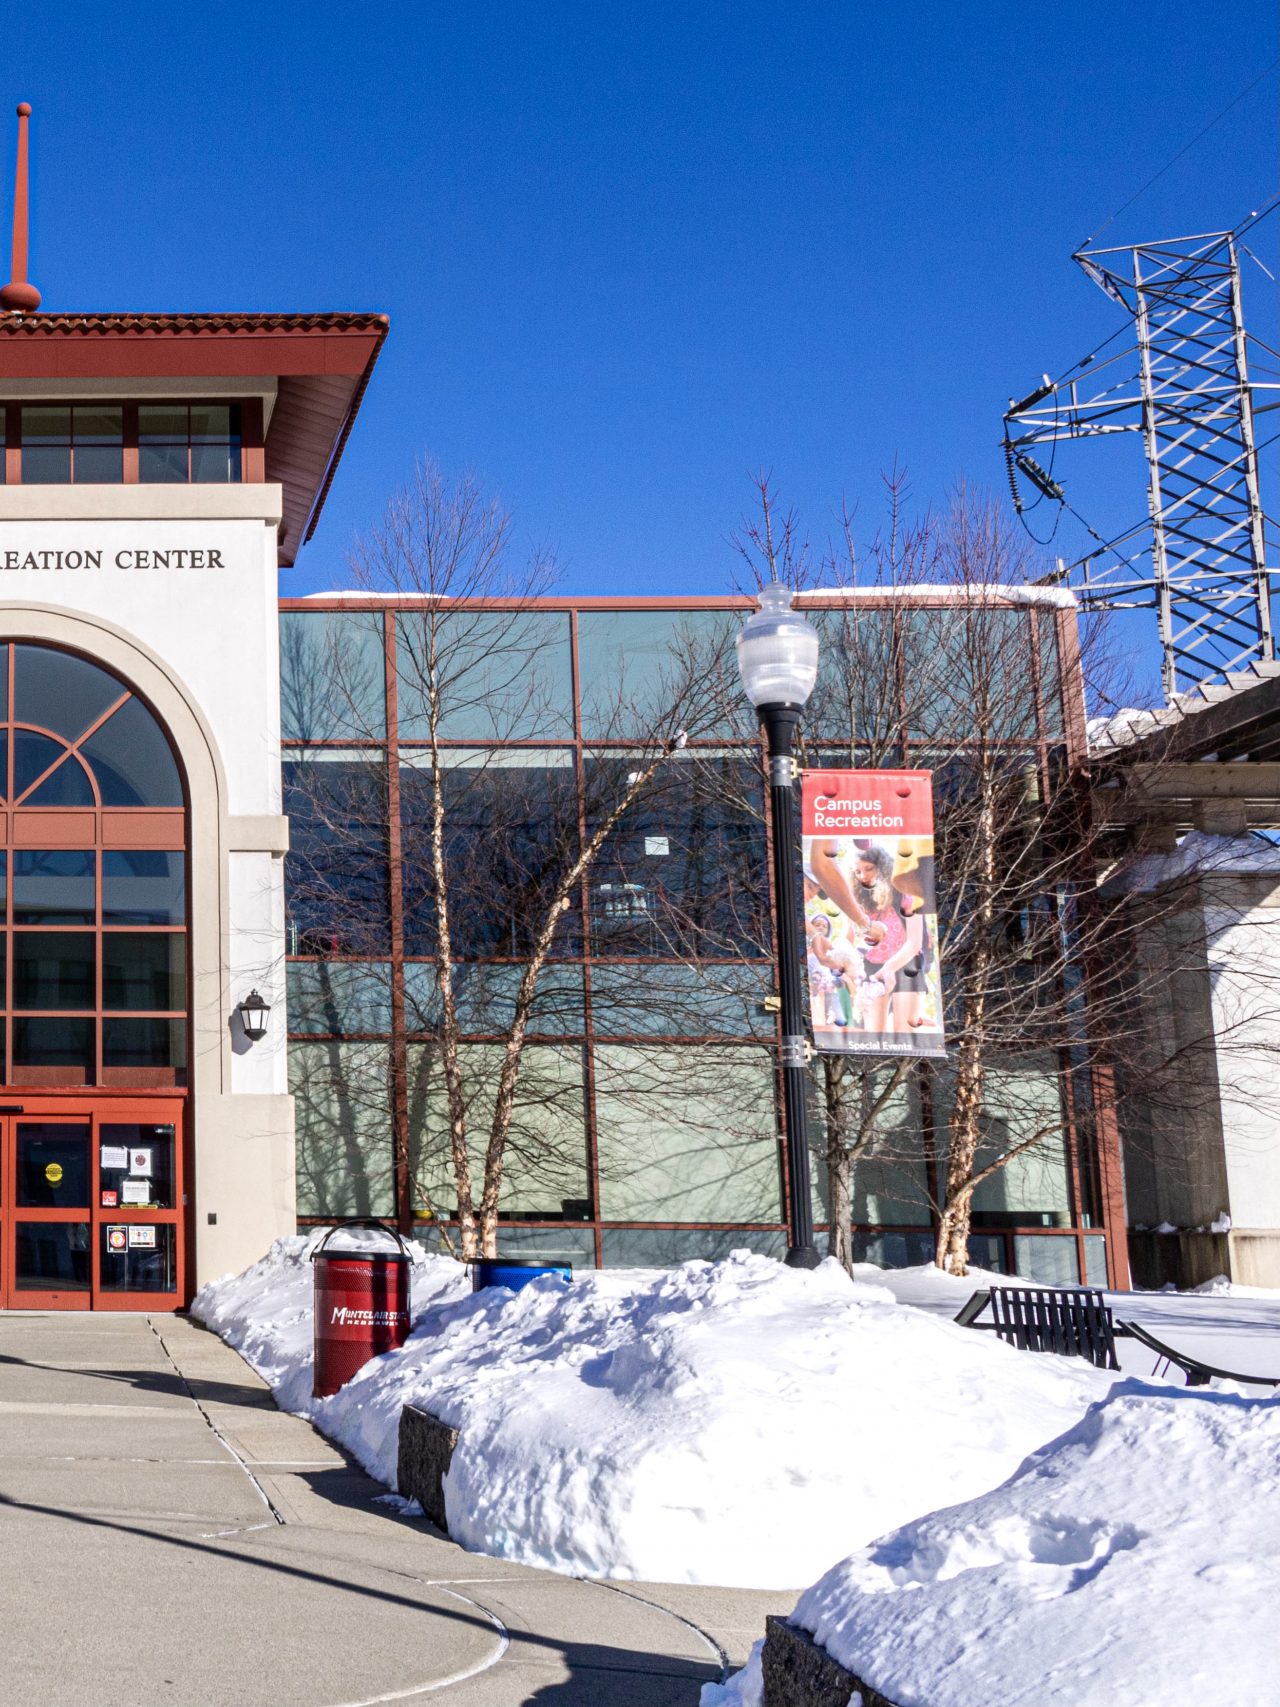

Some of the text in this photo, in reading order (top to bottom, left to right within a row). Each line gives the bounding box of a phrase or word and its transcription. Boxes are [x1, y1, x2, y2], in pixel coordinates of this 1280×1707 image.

[114, 549, 226, 570] CENTER
[814, 796, 881, 814] Campus
[814, 813, 903, 827] Recreation
[848, 1041, 912, 1051] Special Events
